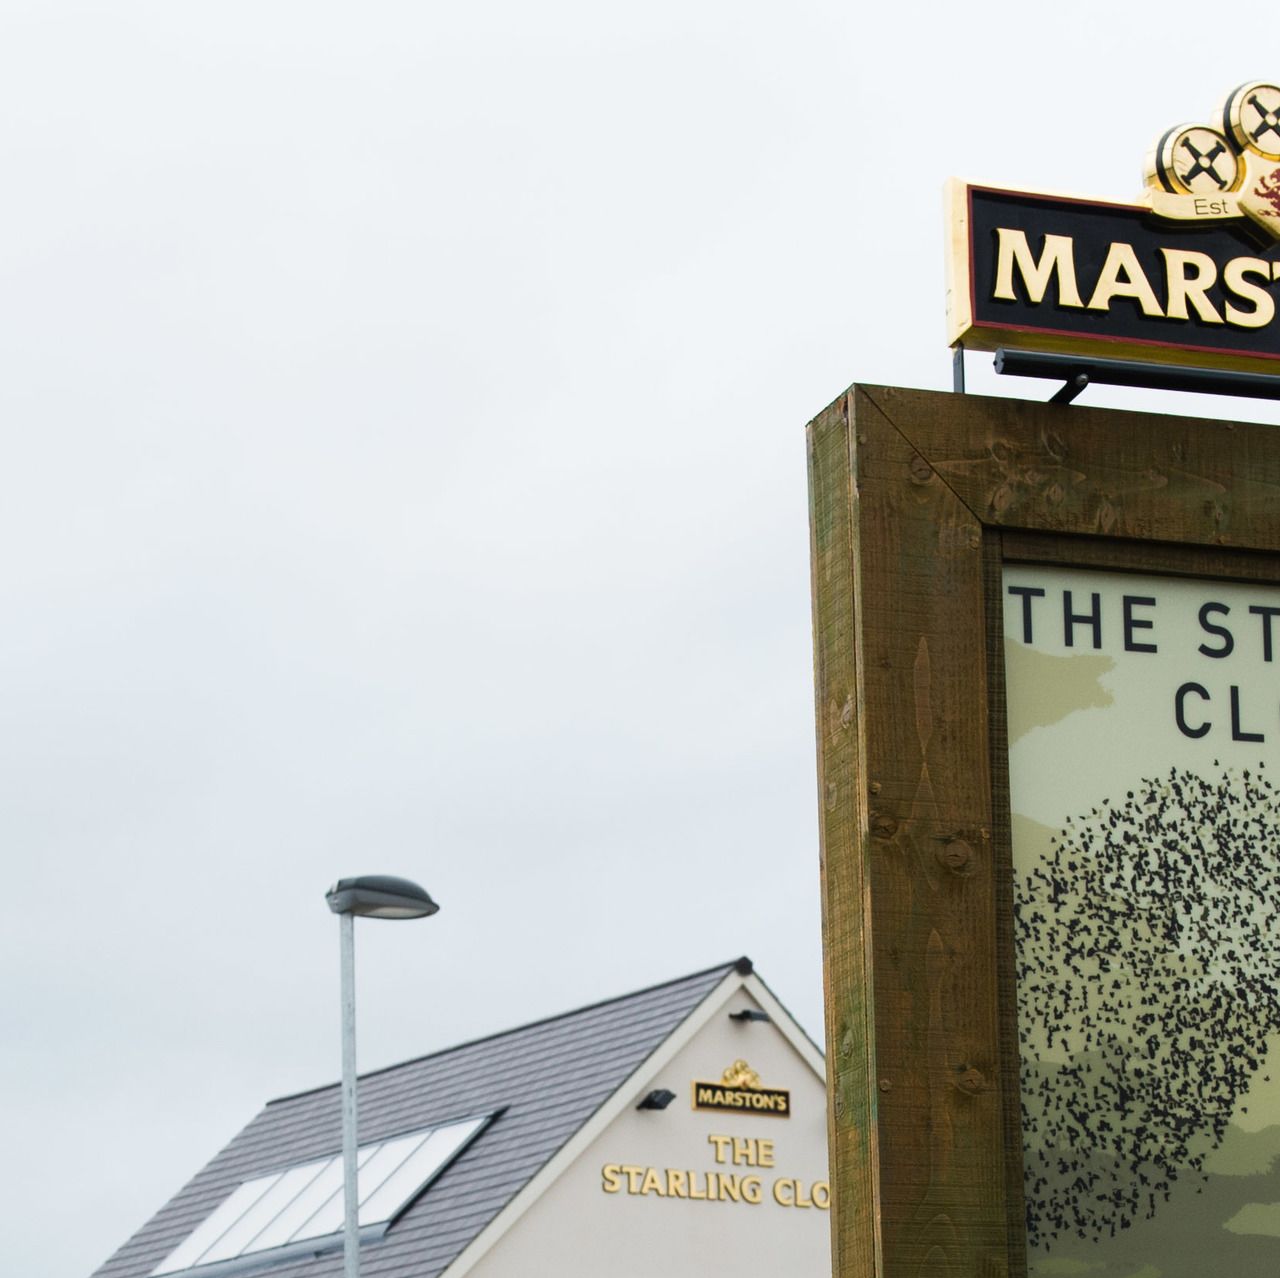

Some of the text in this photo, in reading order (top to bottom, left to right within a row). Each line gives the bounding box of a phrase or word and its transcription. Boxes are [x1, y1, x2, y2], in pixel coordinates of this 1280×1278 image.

[1194, 198, 1228, 216] Est
[1007, 585, 1158, 654] THE
[697, 1087, 787, 1112] MARSTON'S
[708, 1134, 776, 1168] THE
[602, 1163, 830, 1210] STARLING CLO
